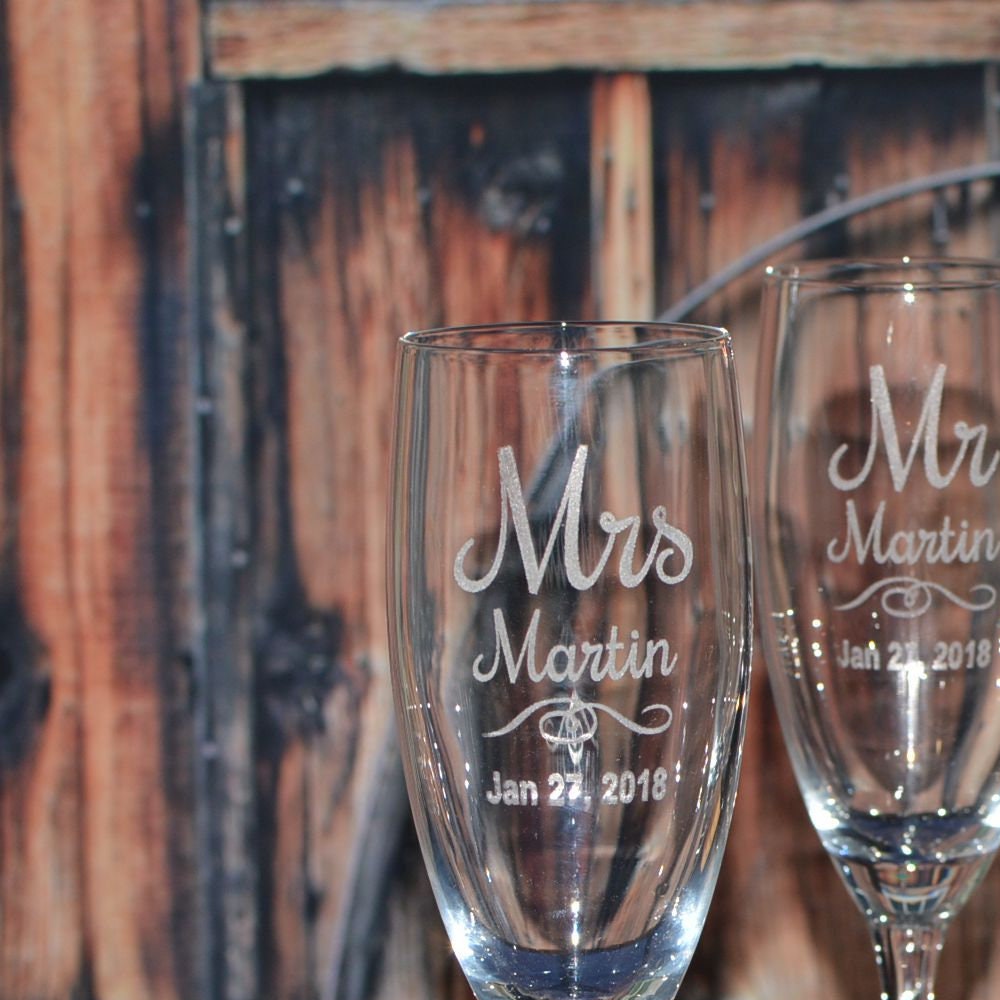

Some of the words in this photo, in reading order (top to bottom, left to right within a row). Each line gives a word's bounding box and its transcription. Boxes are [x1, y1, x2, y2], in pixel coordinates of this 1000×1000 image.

[828, 363, 1000, 492] Mr
[454, 444, 693, 595] Mrs
[827, 499, 1000, 565] Martin
[472, 608, 678, 684] Martin
[836, 639, 881, 671] Jan
[932, 639, 992, 671] 2018
[486, 770, 539, 807] Jan
[602, 766, 668, 807] 2018
